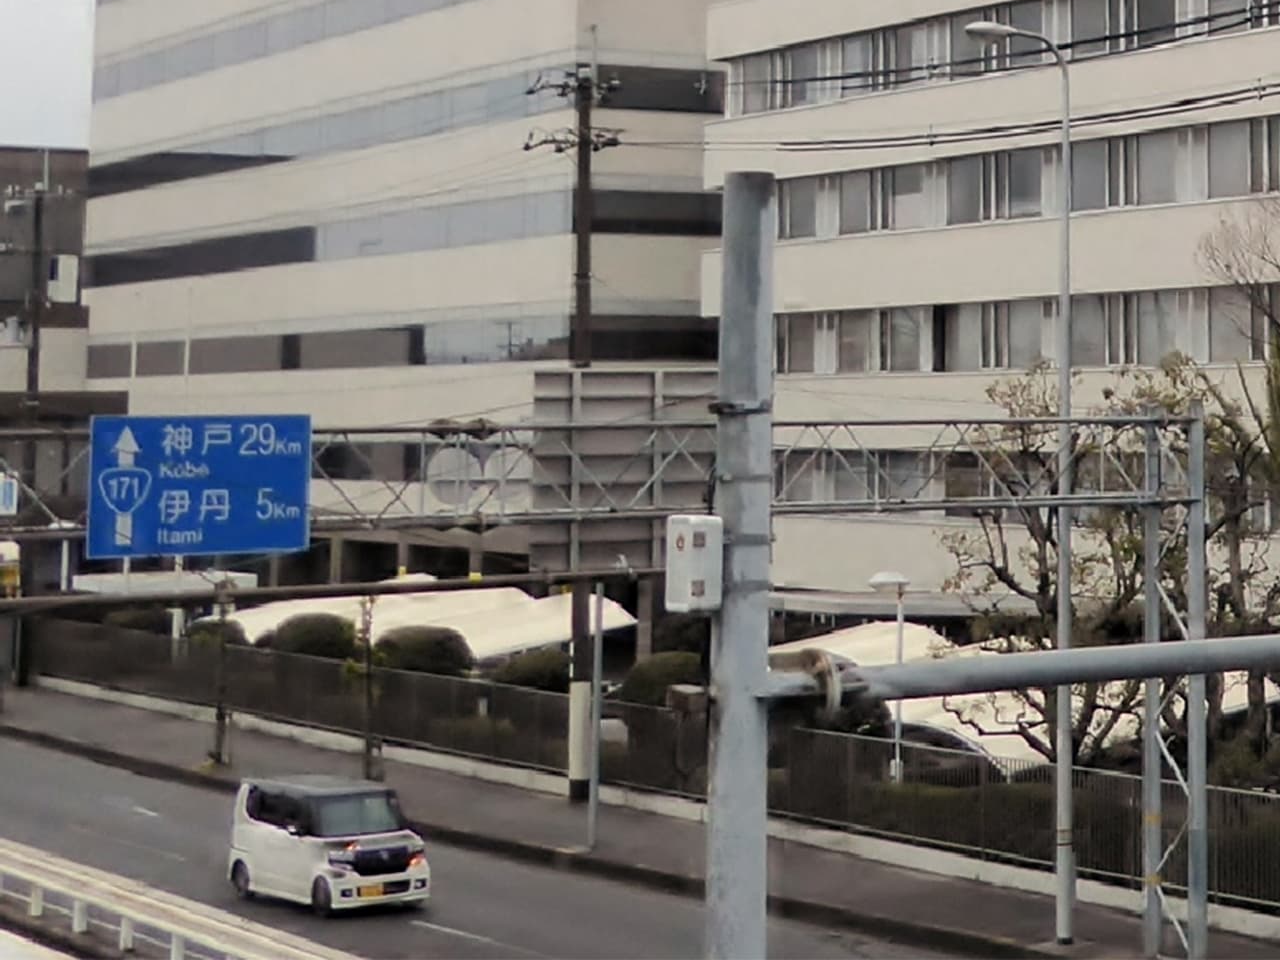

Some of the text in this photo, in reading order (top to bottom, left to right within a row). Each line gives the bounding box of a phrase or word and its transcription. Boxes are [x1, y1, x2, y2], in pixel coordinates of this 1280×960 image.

[162, 423, 232, 456] 神戸
[108, 476, 139, 500] 171
[158, 488, 230, 524] 伊丹
[157, 527, 203, 544] Itami
